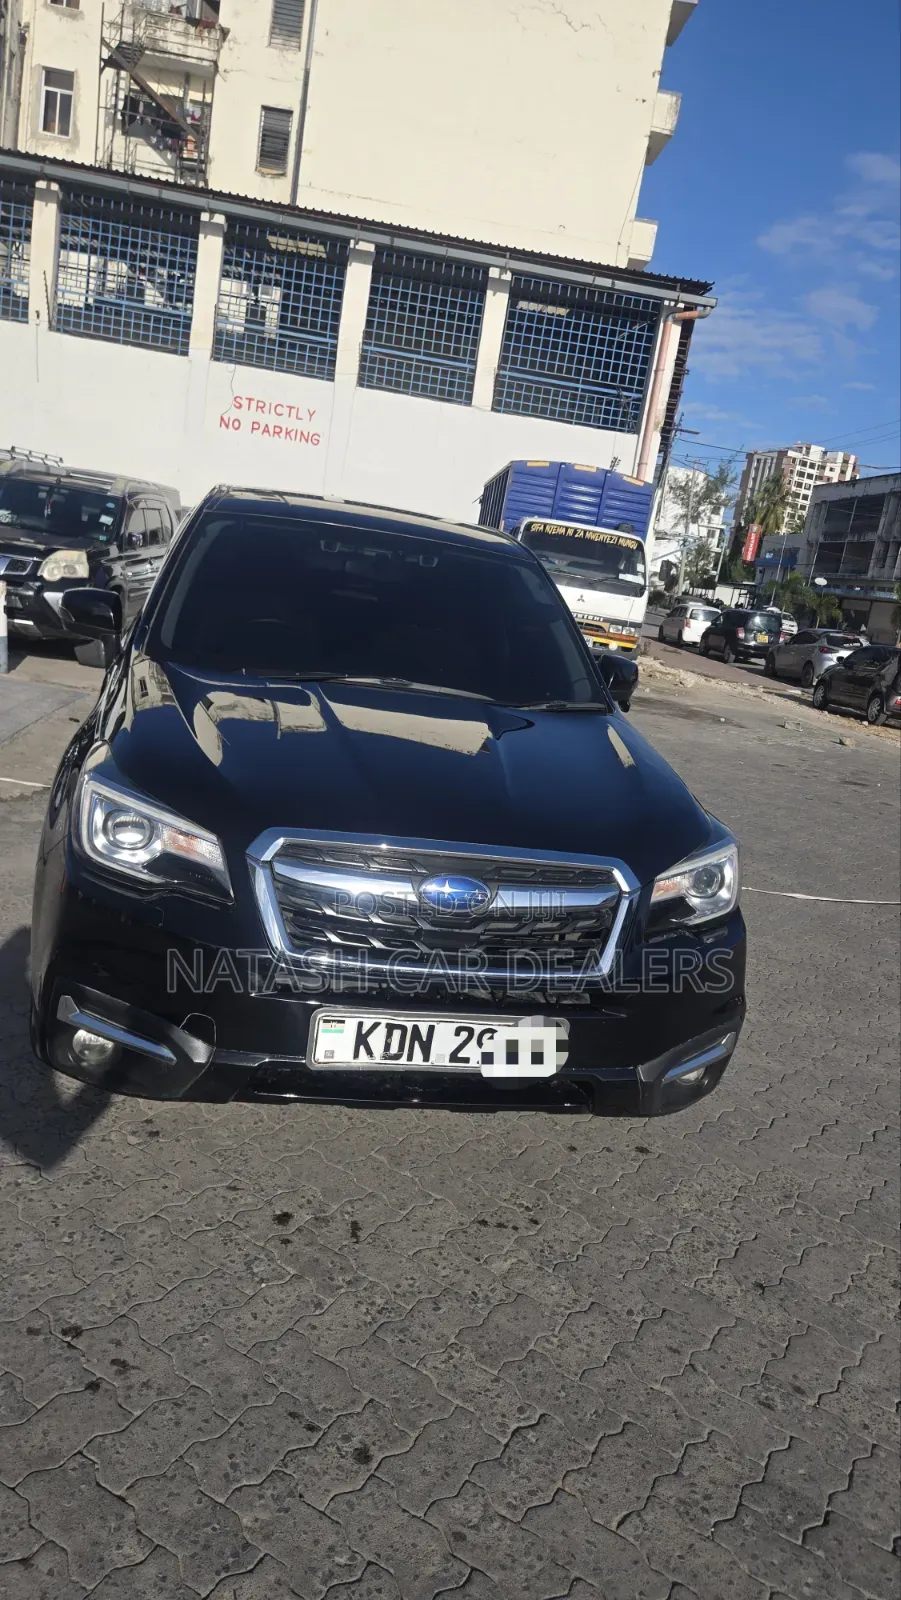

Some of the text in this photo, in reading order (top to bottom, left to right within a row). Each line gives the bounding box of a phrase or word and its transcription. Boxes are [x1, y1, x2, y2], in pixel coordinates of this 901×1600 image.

[232, 395, 316, 422] STRICTLY
[219, 414, 321, 446] NO PARKING
[545, 525, 566, 535] NJEMA
[565, 527, 574, 537] NI
[574, 529, 584, 539] ZA
[584, 531, 618, 544] MWENYEZI
[618, 537, 638, 550] MUNGU
[353, 1021, 436, 1063] KDN
